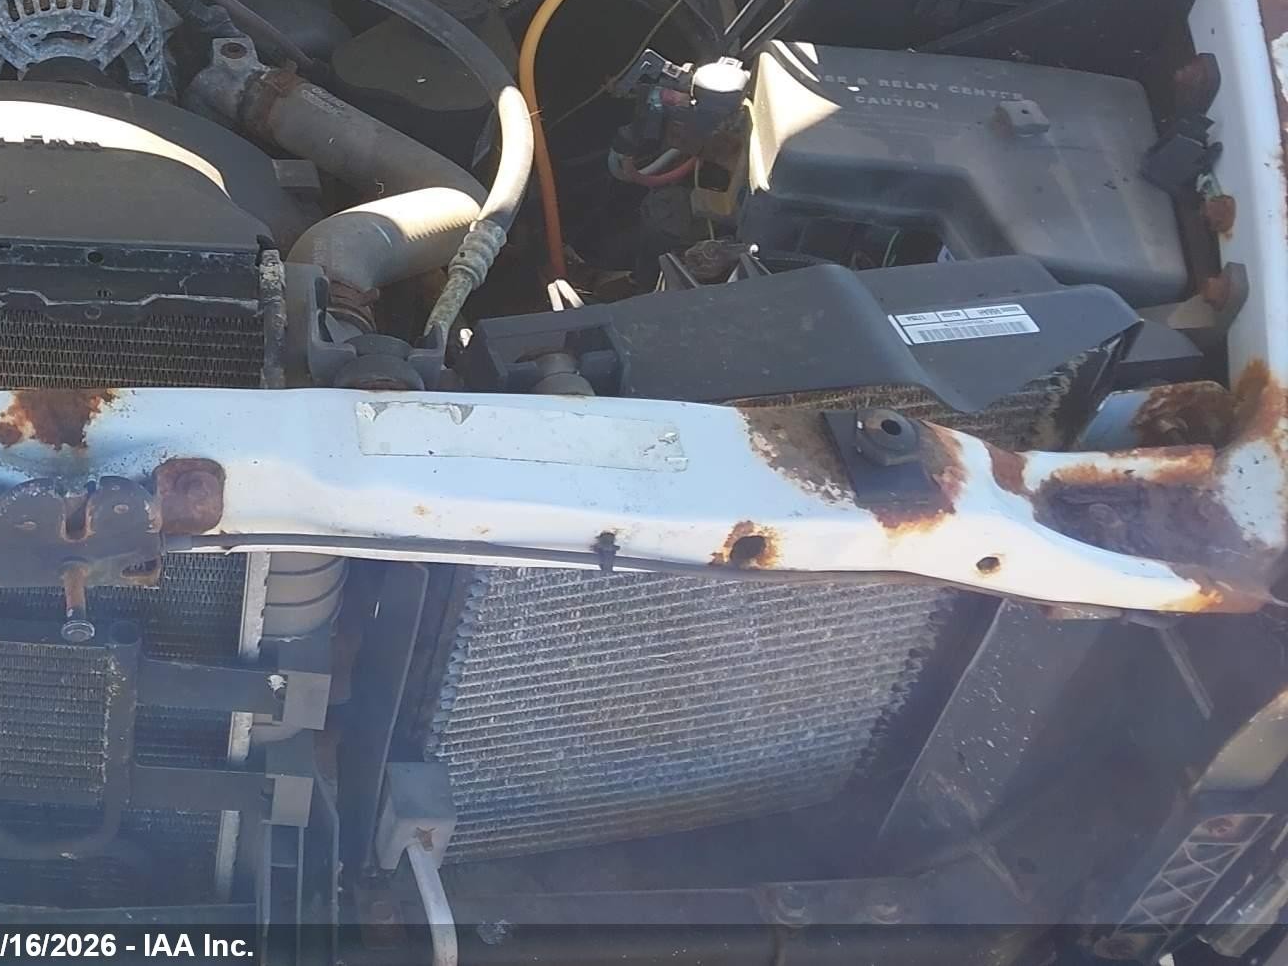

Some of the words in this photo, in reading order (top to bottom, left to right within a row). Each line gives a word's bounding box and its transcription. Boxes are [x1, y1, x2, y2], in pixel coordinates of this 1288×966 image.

[879, 78, 940, 92] RELAY
[949, 85, 1025, 101] CENTER
[855, 96, 940, 111] CAUTION
